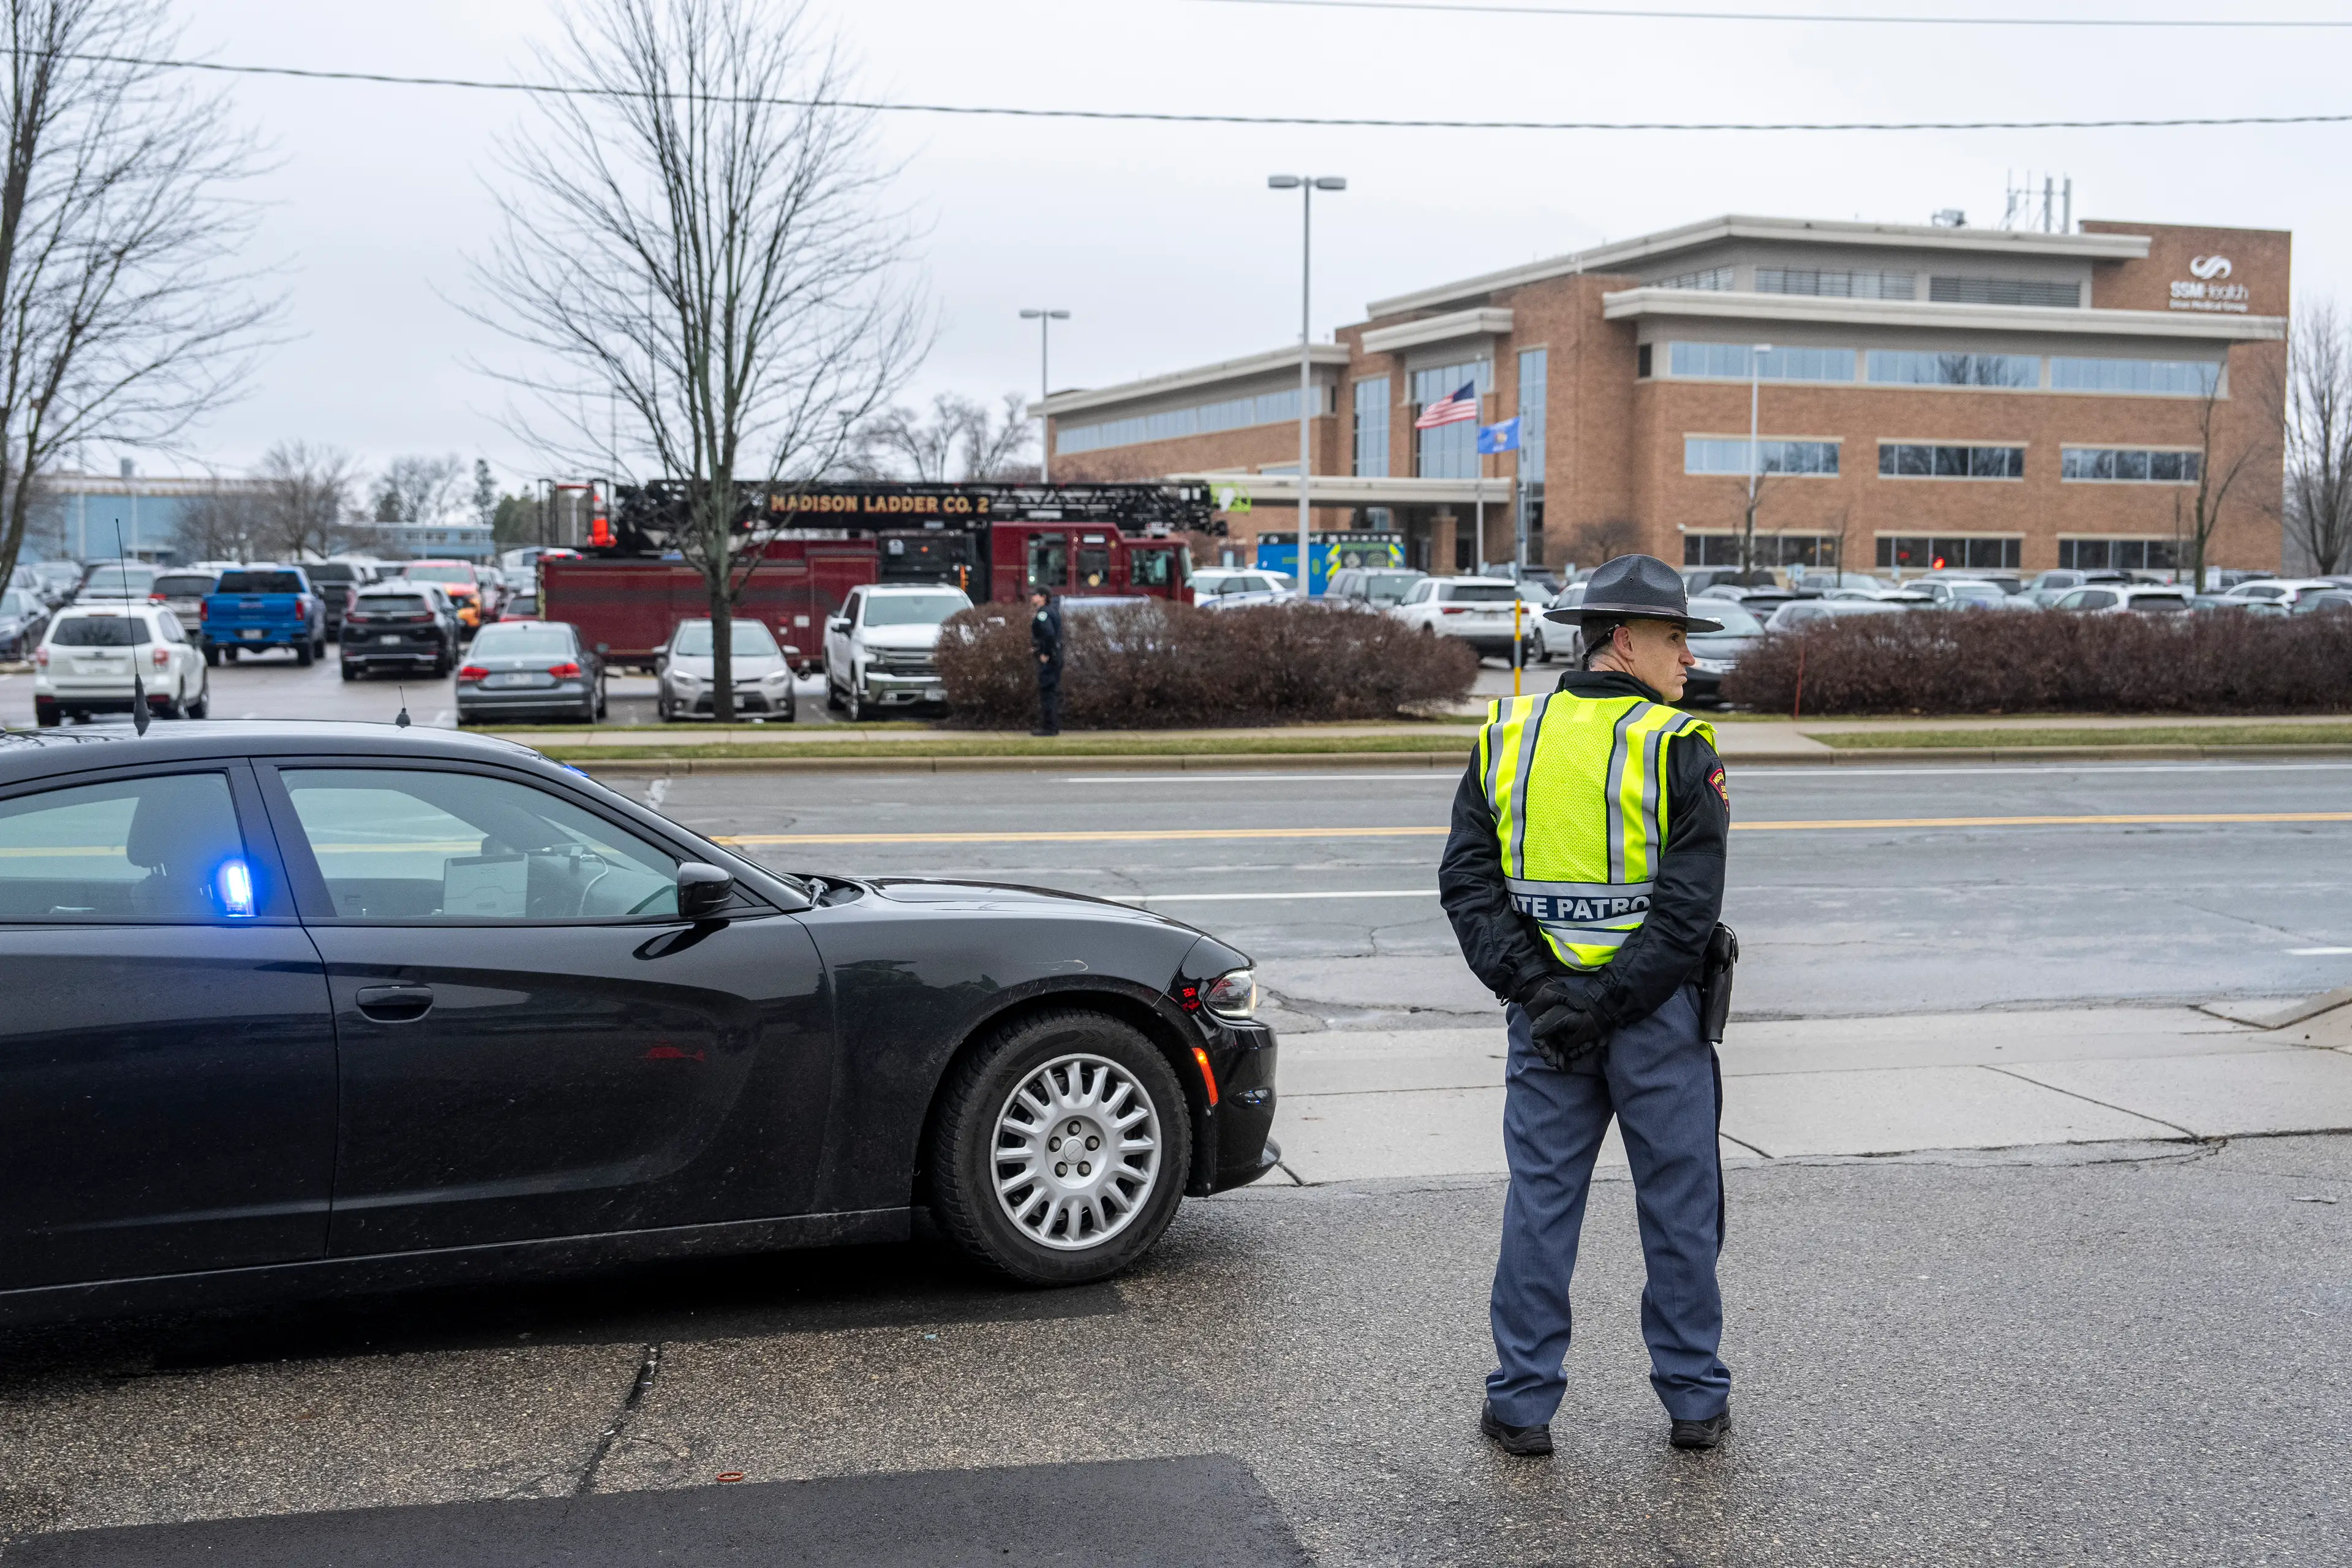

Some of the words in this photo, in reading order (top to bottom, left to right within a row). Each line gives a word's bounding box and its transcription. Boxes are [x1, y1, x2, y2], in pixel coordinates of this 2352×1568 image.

[2170, 281, 2204, 298] SSM
[771, 495, 858, 513] MADISON
[864, 496, 938, 513] LADDER
[943, 496, 973, 514] CO.
[977, 497, 989, 514] 2
[1508, 893, 1548, 918] ATE
[1556, 896, 1651, 919] PATRO
